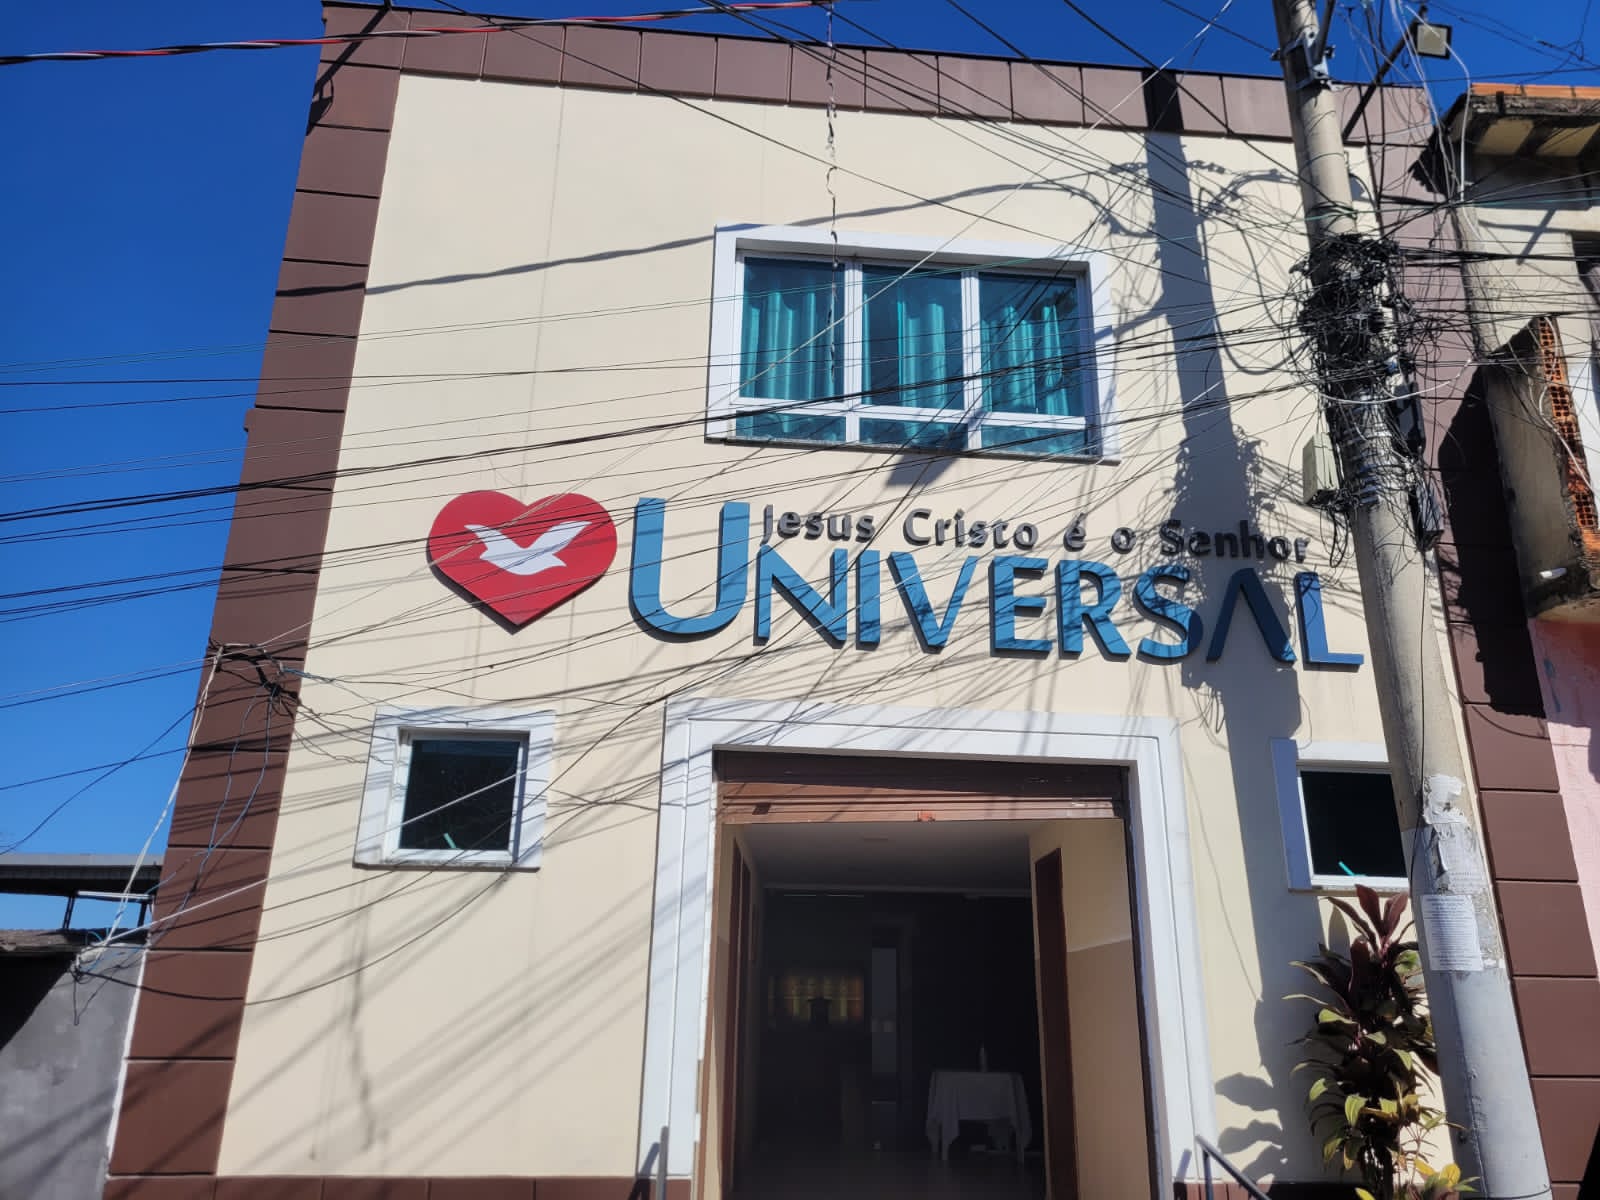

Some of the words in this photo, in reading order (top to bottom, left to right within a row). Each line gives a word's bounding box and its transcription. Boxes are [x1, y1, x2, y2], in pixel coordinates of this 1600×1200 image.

[629, 497, 1365, 666] UNIVERSAL
[760, 504, 876, 545] Jesus
[903, 508, 1038, 549] Cristo
[1063, 512, 1087, 551] é
[1111, 526, 1137, 555] o
[1159, 519, 1310, 562] Senhor
